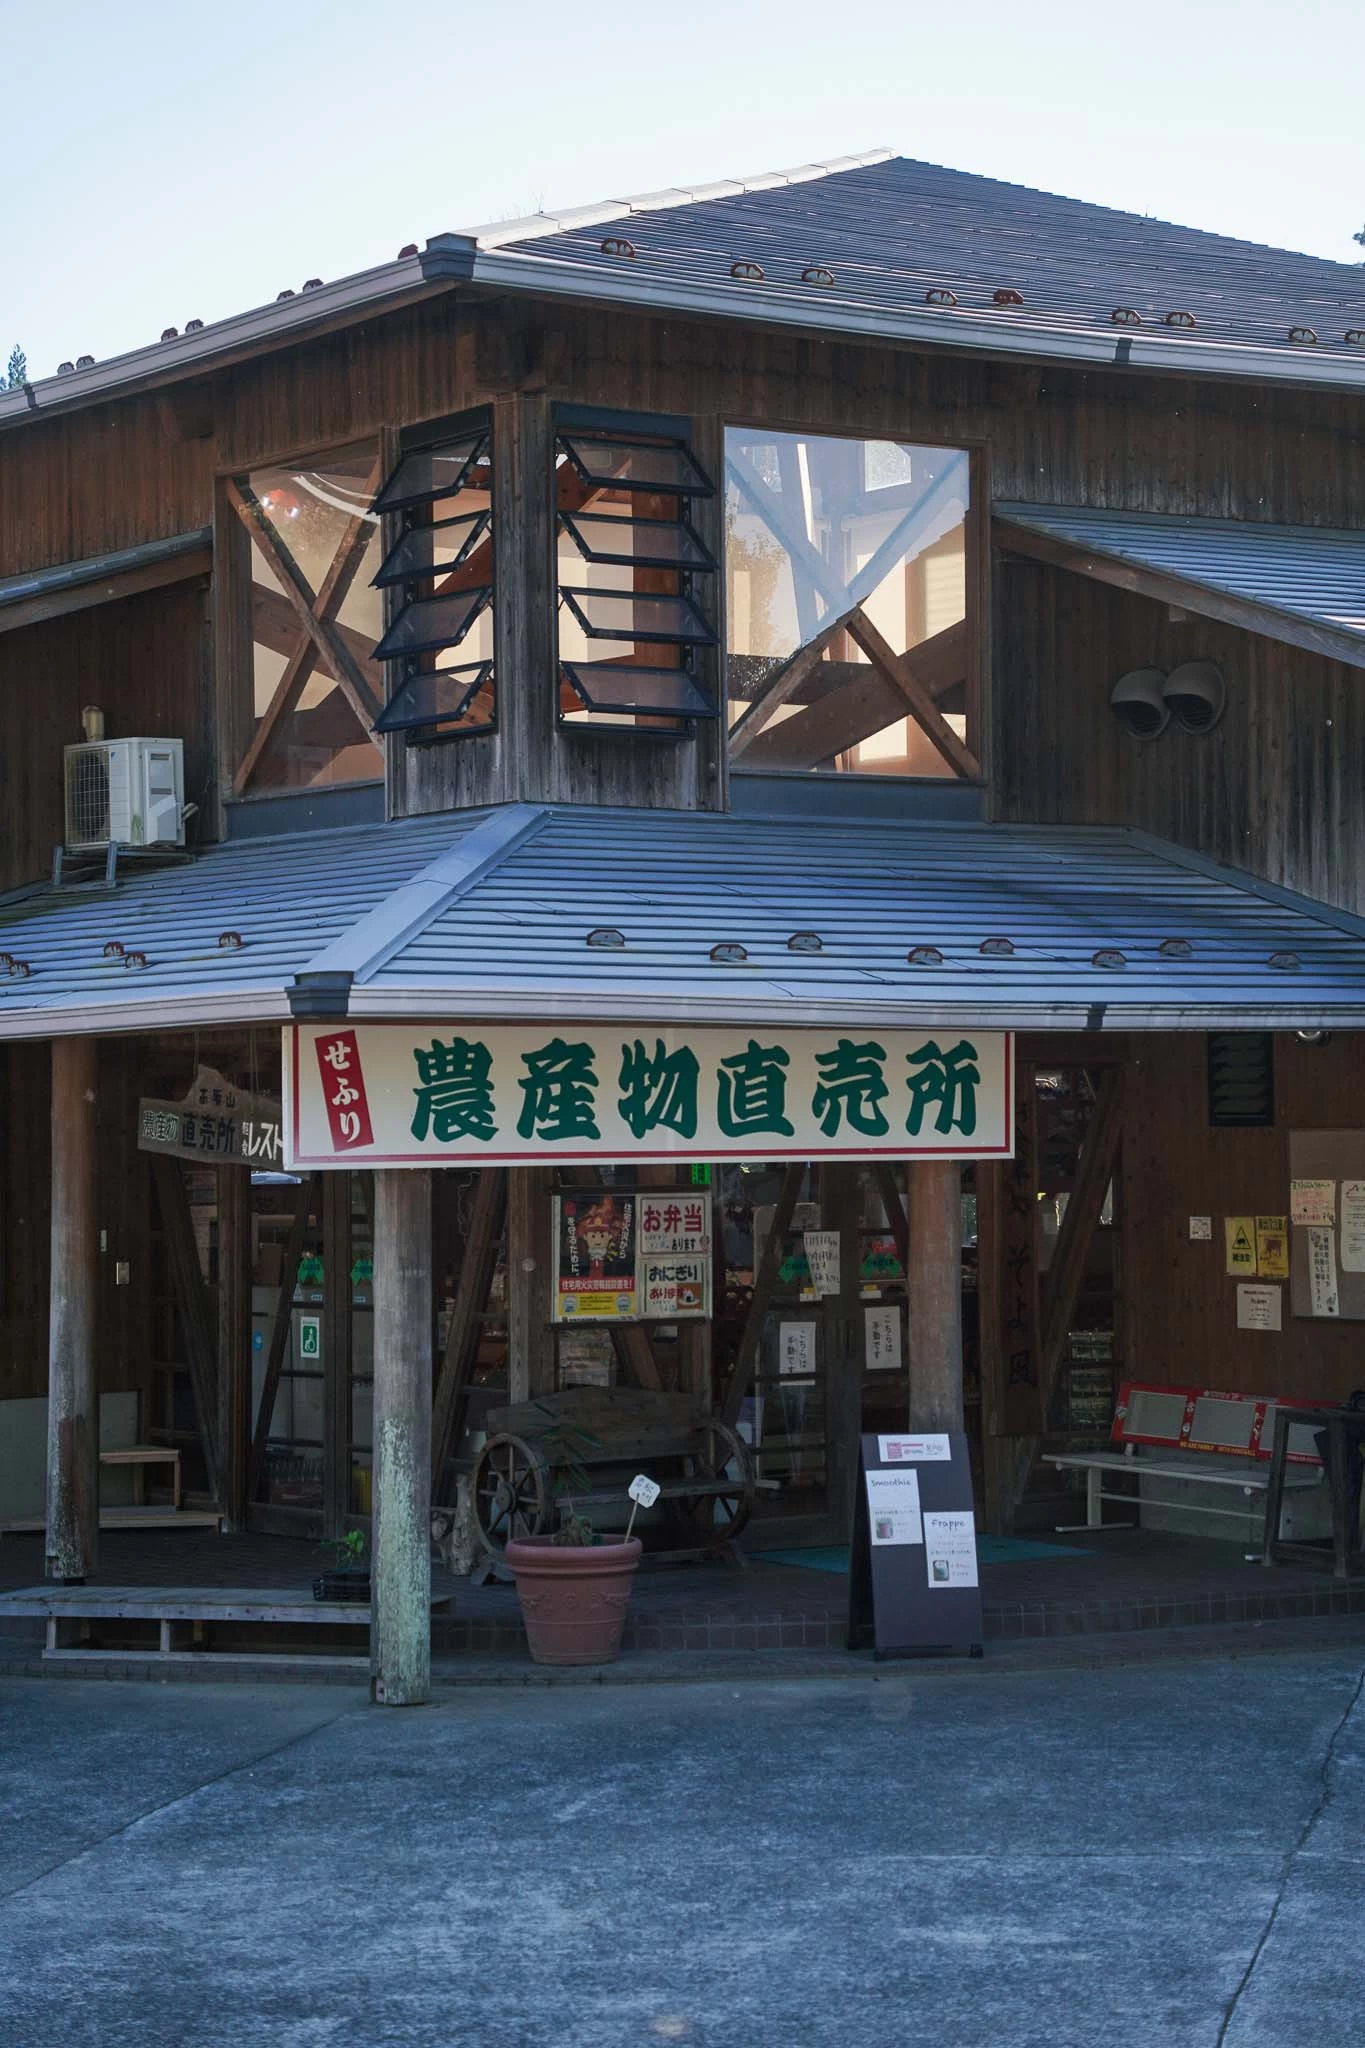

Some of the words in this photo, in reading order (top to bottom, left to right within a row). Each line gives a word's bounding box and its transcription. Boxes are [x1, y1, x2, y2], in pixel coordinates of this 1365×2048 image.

[323, 1040, 361, 1143] せふり
[410, 1038, 979, 1141] 農産物直売所
[643, 1204, 702, 1233] お弁当
[671, 1238, 696, 1251] あります
[649, 1264, 697, 1282] おにぎり
[932, 1518, 966, 1533] Frappe
